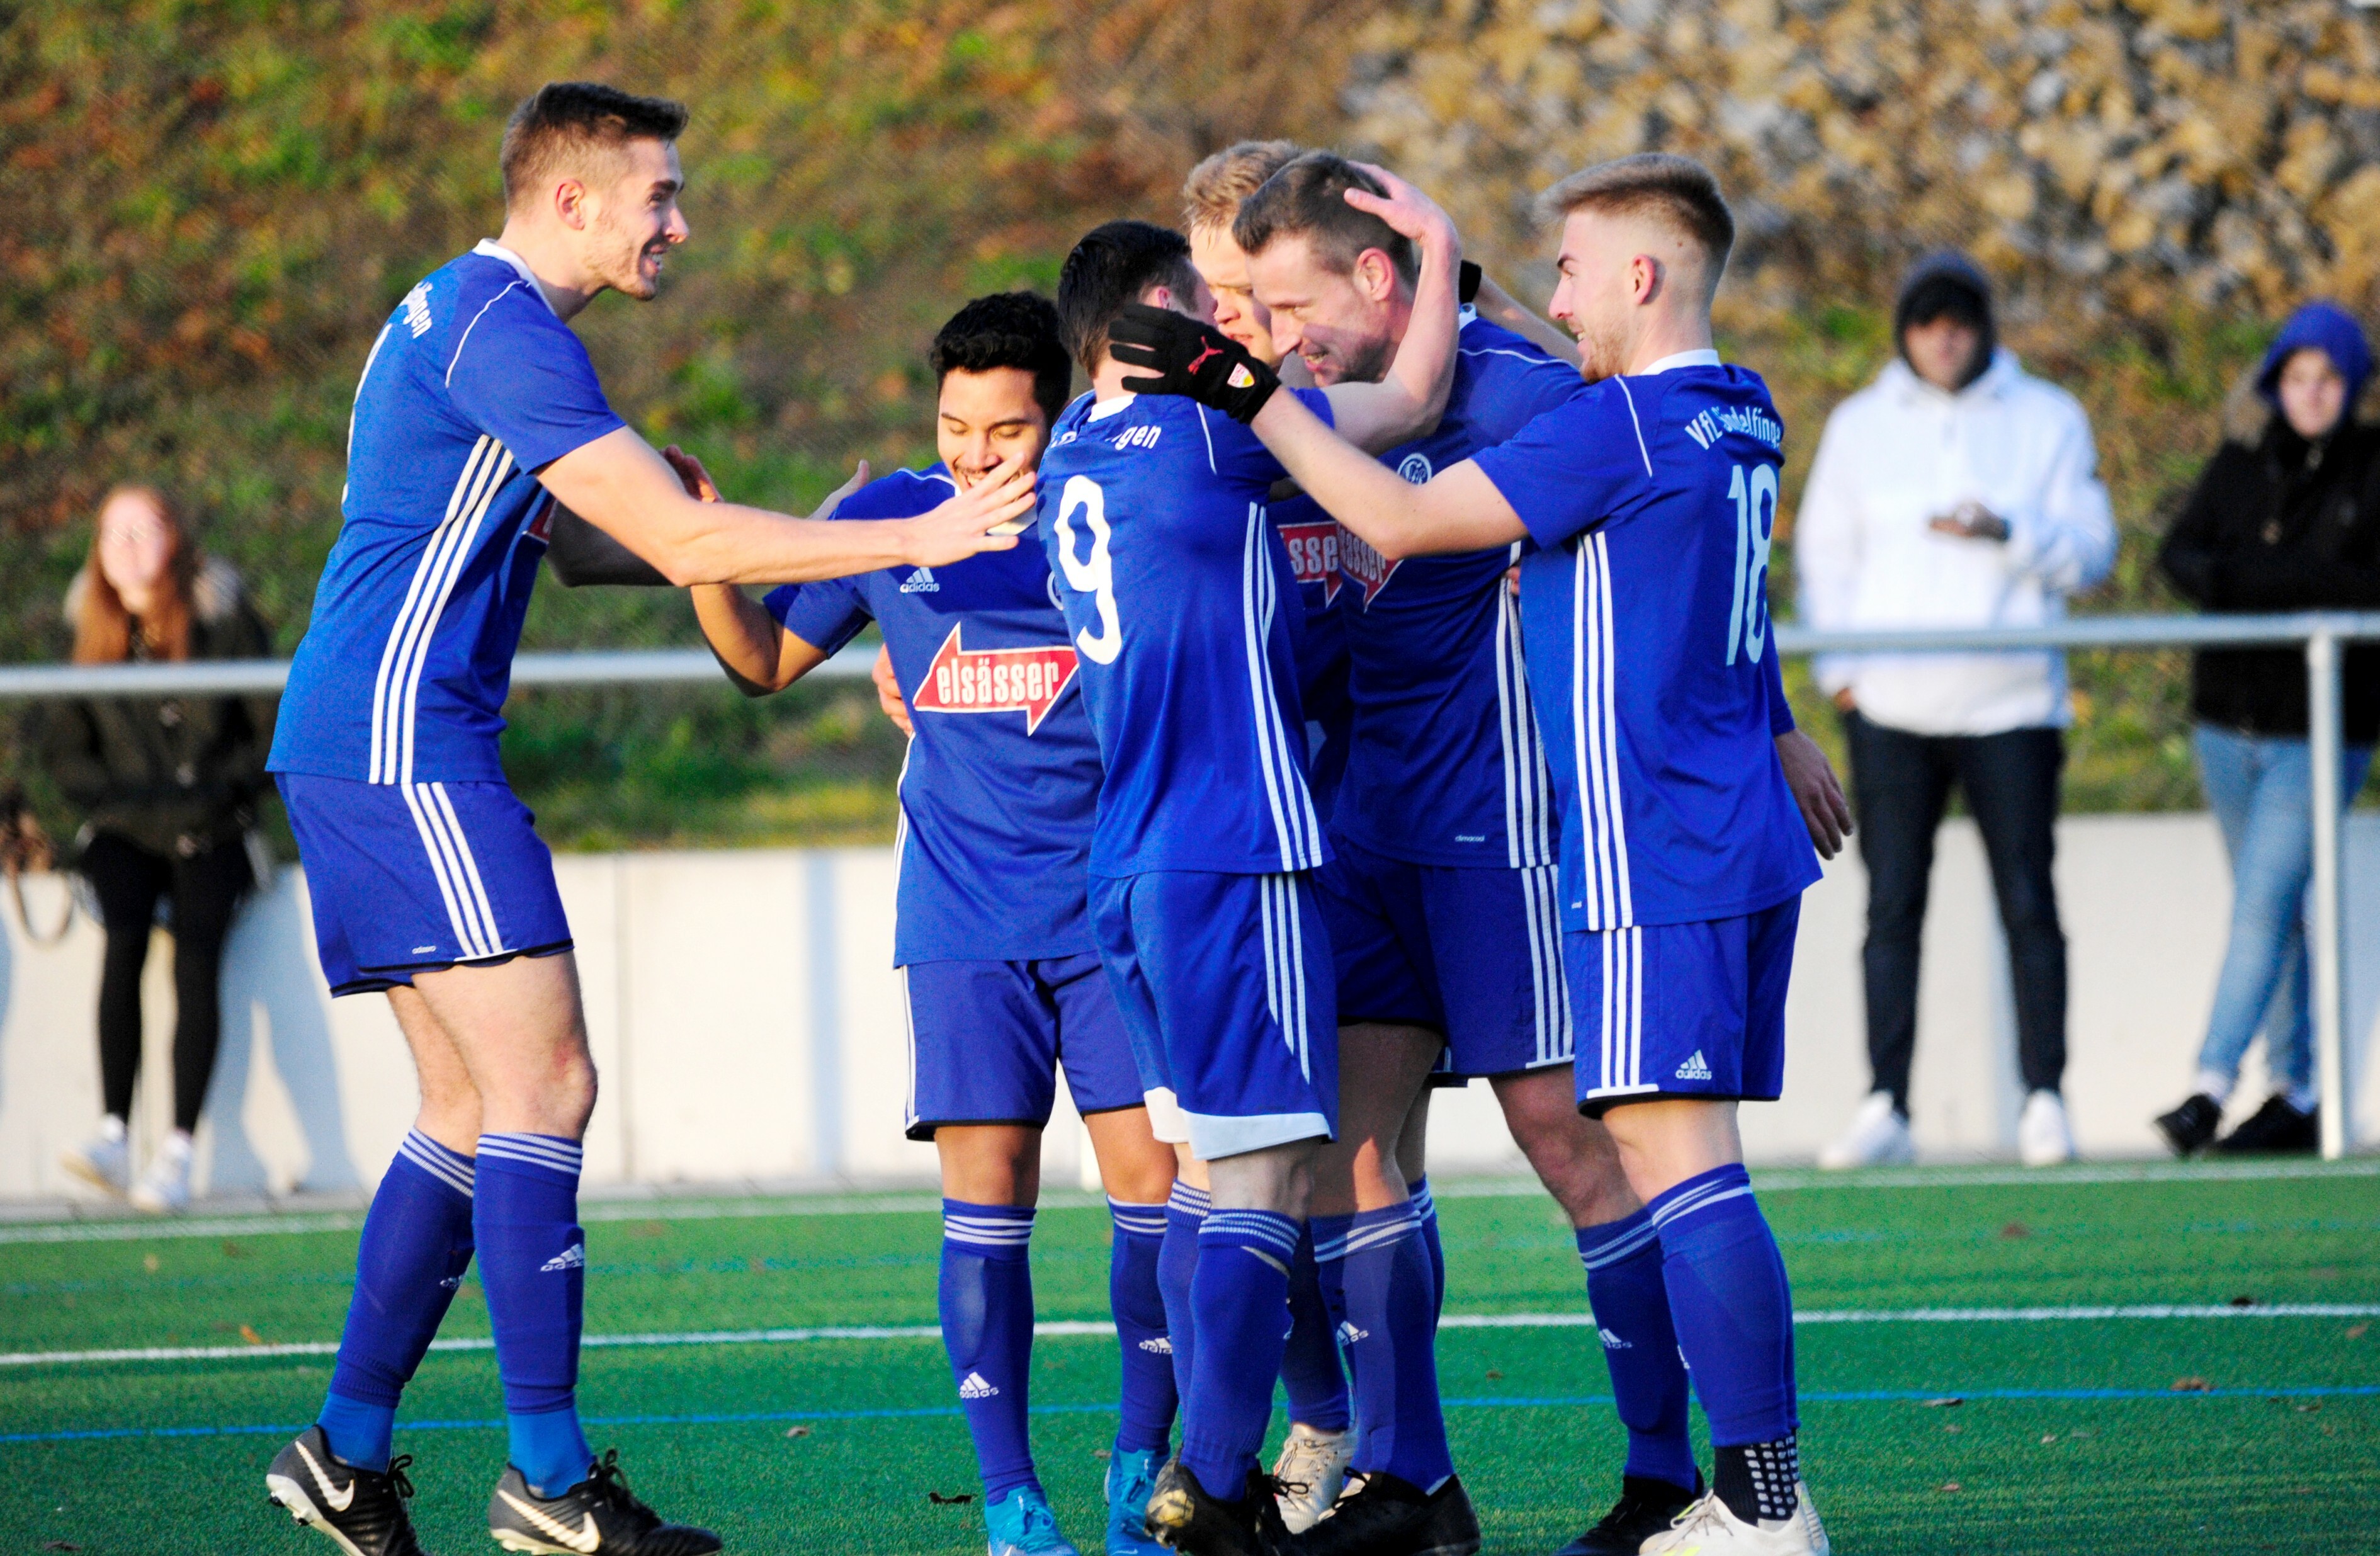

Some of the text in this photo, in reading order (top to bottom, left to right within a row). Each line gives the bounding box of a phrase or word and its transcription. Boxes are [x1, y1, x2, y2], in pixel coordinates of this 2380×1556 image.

[1684, 410, 1723, 450] VfL
[1054, 475, 1122, 664] 9
[1726, 464, 1777, 666] 18
[900, 582, 939, 593] adidas
[936, 657, 1059, 704] elsässer
[1675, 1069, 1712, 1080] adidas
[960, 1387, 999, 1399] adidas
